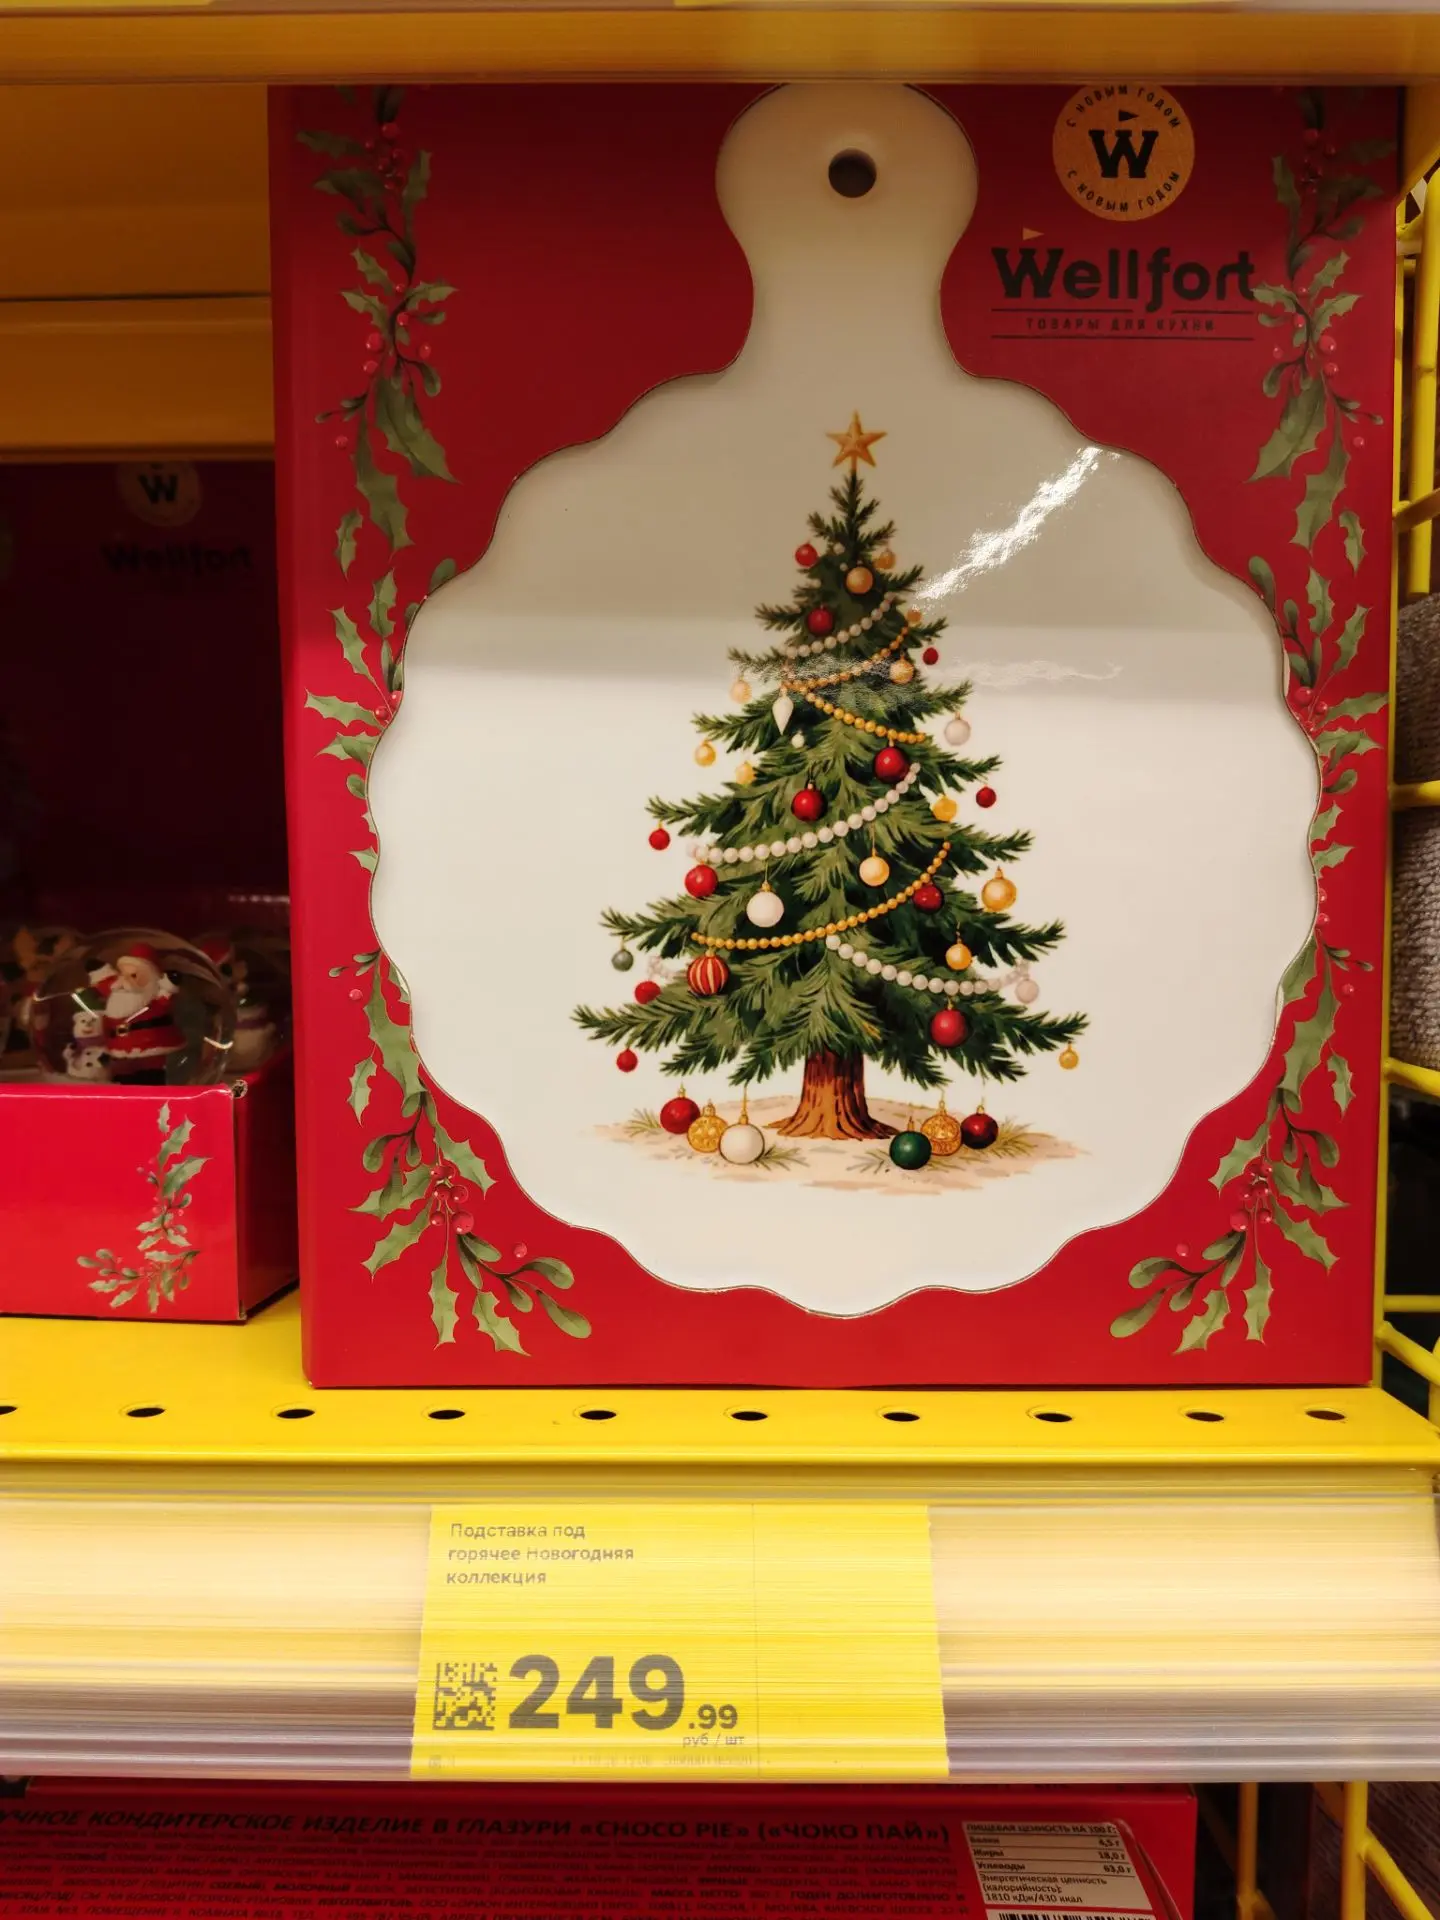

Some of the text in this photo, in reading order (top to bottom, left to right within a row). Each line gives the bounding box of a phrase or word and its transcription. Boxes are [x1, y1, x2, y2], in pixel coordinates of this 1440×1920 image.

[1075, 83, 1129, 113] НОВЫМ
[1136, 85, 1181, 129] ГОДОМ
[1076, 182, 1129, 212] НОВЫМ
[1137, 171, 1181, 211] ГОДОМ
[991, 245, 1257, 315] Wellfort
[1026, 316, 1215, 333] ТОВАРЫ ДЛЯ КУХНИ
[450, 1523, 586, 1542] Подставка под
[448, 1546, 634, 1564] горячее Новогодняя
[446, 1569, 547, 1587] коллекция
[507, 1653, 685, 1731] 249
[682, 1732, 709, 1749] руб
[88, 1810, 296, 1832] КОНДИТЕРСКОЕ
[303, 1814, 423, 1835] ИЗДЕЛИЕ
[432, 1818, 449, 1834] В
[455, 1817, 572, 1836] ГЛАЗУРИ
[966, 1823, 1016, 1832] ПИЩЕВАЯ
[1018, 1824, 1070, 1833] ЦЕННОСТЬ
[1072, 1825, 1087, 1833] НА
[976, 1861, 1026, 1871] Углеводы
[980, 1873, 1108, 1885] Энергетическая ценность
[985, 1893, 1011, 1902] 1810
[1060, 1895, 1083, 1903] ккал
